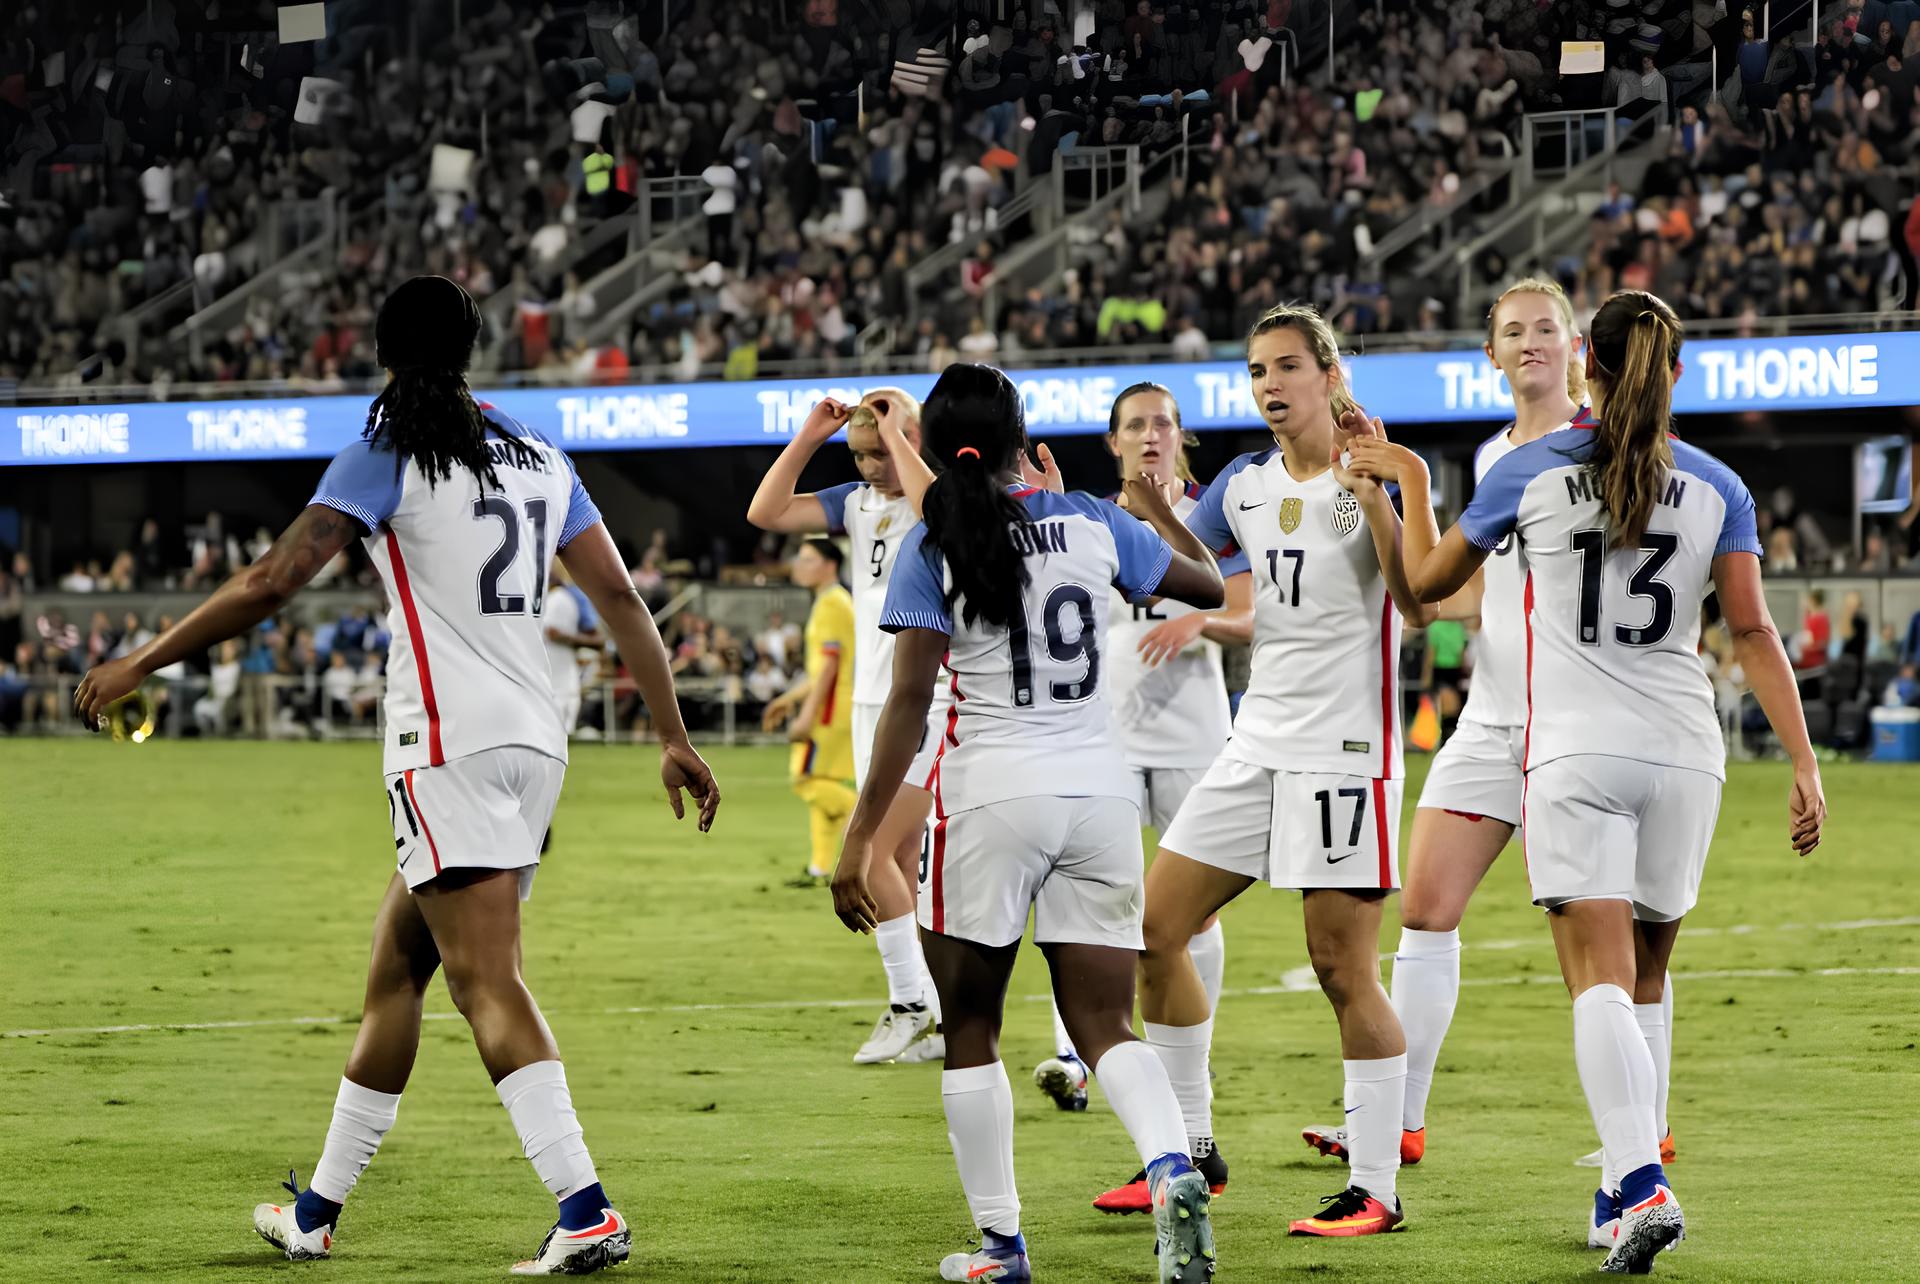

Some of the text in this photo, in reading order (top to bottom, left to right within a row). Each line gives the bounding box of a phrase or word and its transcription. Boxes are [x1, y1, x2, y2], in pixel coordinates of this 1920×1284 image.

[1696, 344, 1879, 400] THORNE
[187, 406, 308, 452] THORNE
[556, 392, 688, 441] THORNE
[1019, 376, 1117, 426] ORNE
[17, 411, 130, 457] THORNE
[472, 494, 548, 618] 21
[870, 539, 886, 578] 9
[1266, 549, 1305, 608] 17
[1569, 527, 1681, 648] 13
[1008, 582, 1100, 709] 19
[1314, 787, 1367, 849] 17
